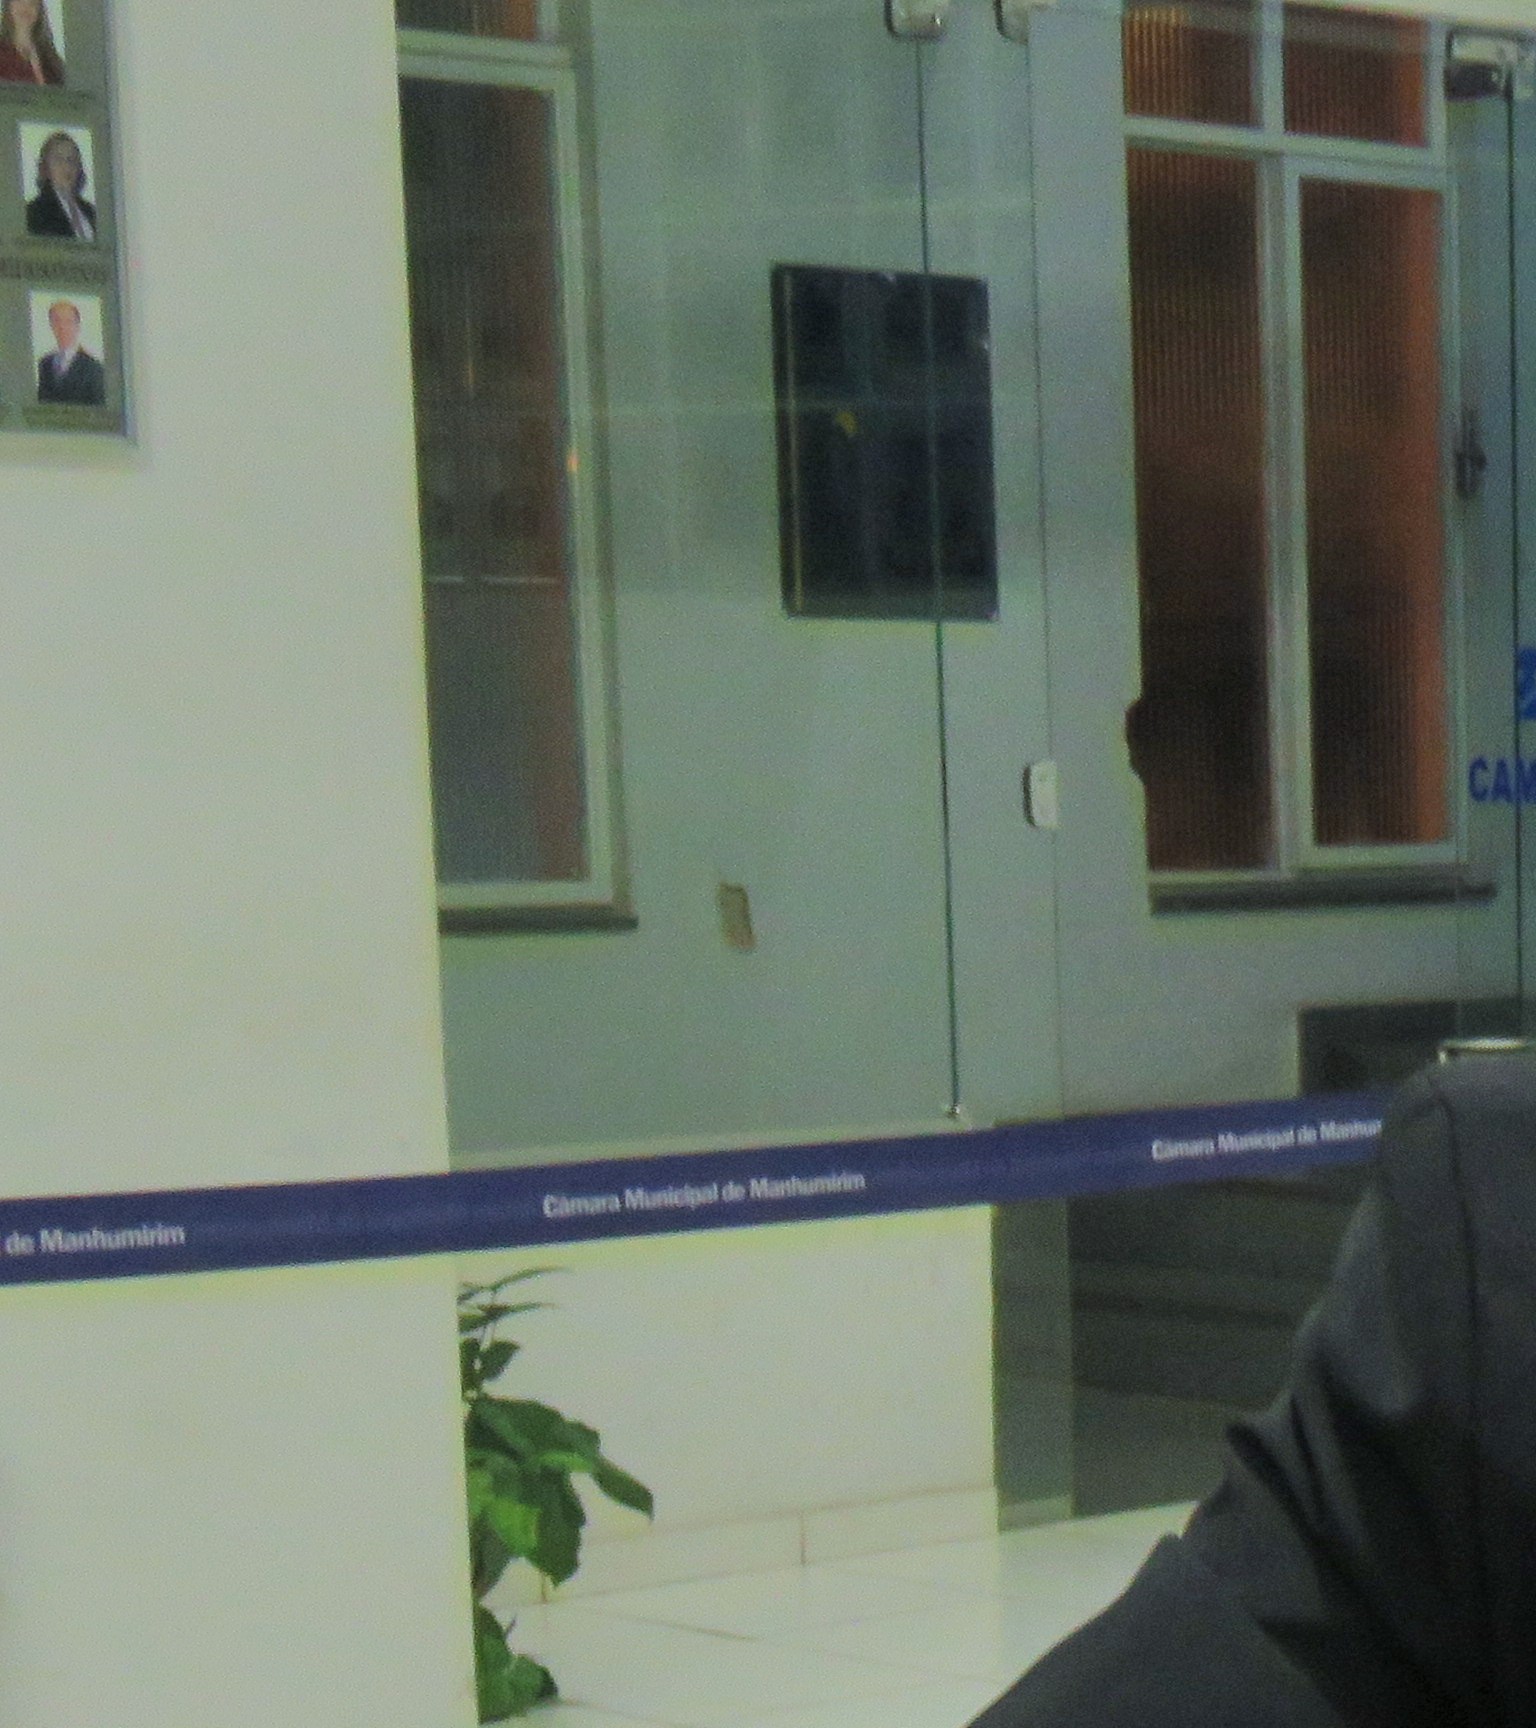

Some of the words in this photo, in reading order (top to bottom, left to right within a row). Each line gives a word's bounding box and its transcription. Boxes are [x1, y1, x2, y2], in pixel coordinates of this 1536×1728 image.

[1297, 1125, 1317, 1143] de
[625, 1183, 718, 1211] Municipal
[722, 1181, 746, 1201] de
[6, 1229, 35, 1256] de
[40, 1223, 186, 1253] Manhumirim
